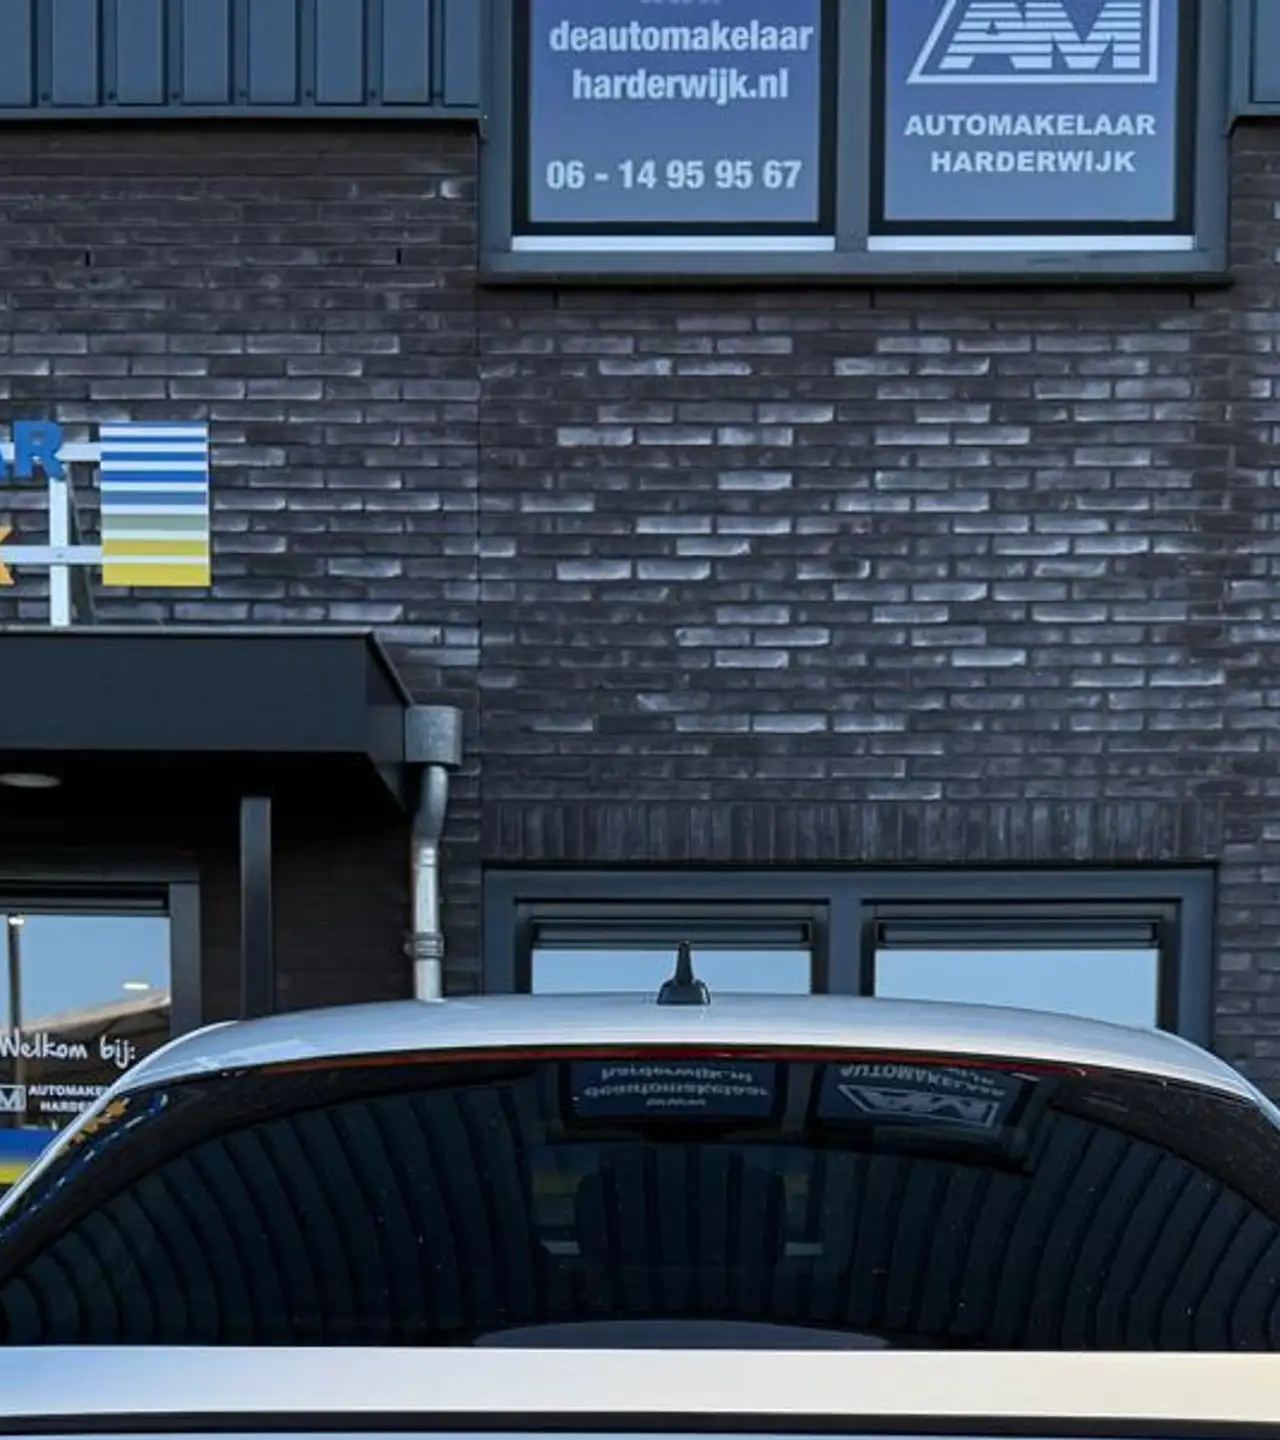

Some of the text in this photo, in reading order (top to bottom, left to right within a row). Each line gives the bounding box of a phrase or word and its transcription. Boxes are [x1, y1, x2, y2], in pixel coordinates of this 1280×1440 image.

[549, 20, 814, 51] deautomakelaar
[572, 67, 789, 106] harderwijk.nl
[904, 114, 1157, 136] AUTOMAKELAAR
[546, 160, 585, 189] 06
[618, 160, 658, 189] 14
[666, 160, 705, 189] 95
[715, 160, 754, 189] 95
[762, 160, 802, 189] 67
[930, 151, 1136, 173] HARDERWIJK
[0, 1029, 88, 1059] Welkom
